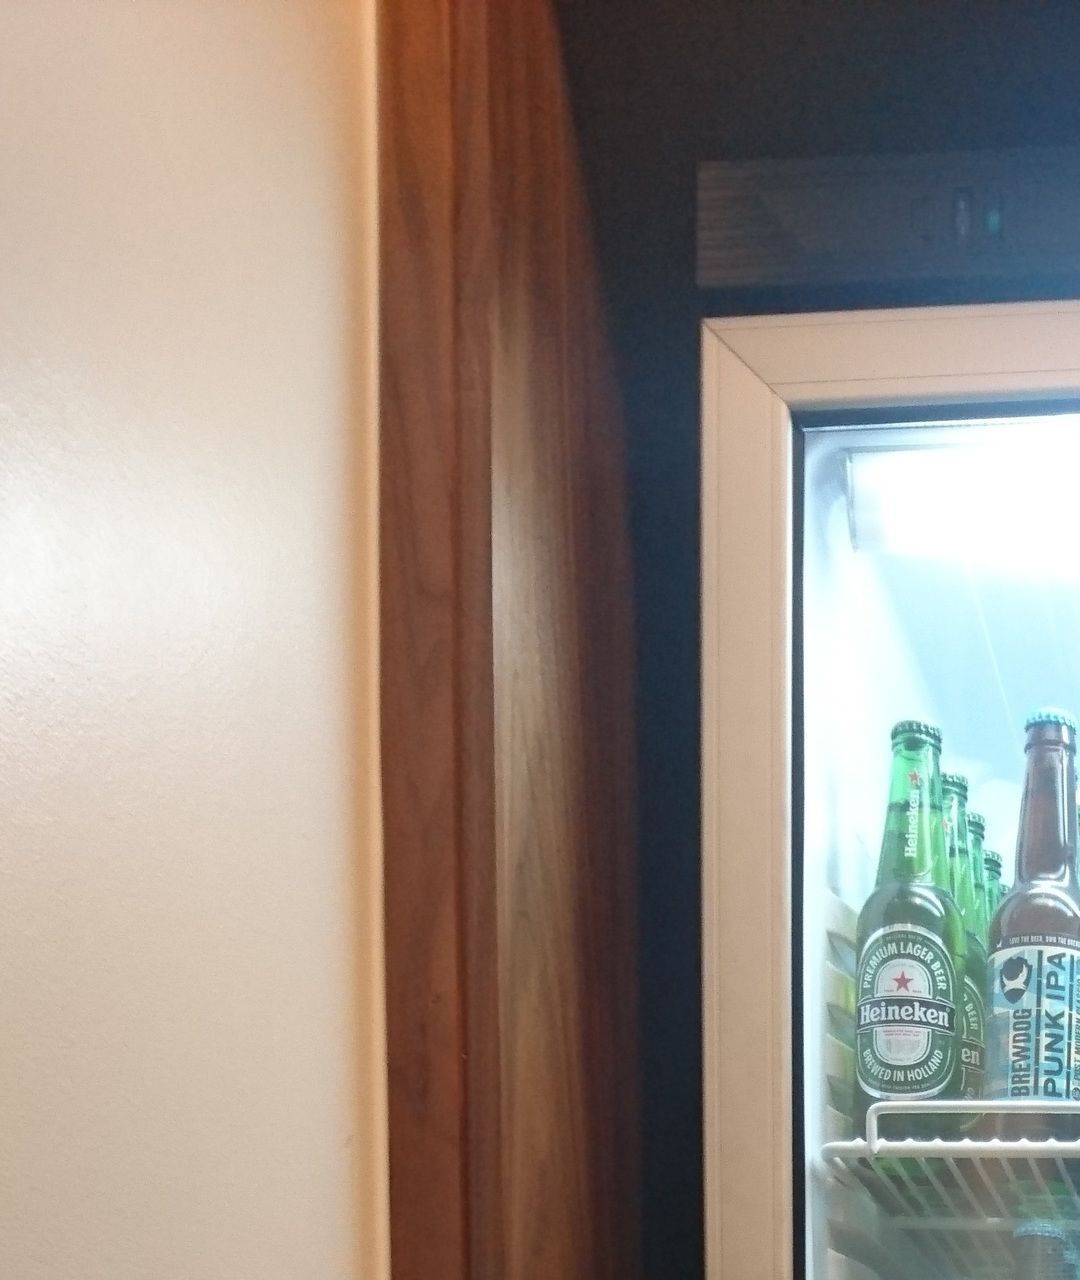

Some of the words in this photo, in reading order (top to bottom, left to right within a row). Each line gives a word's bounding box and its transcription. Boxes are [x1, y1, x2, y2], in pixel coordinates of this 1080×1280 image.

[863, 943, 898, 989] PREMIUM
[900, 941, 936, 964] LAGER
[930, 959, 947, 991] BEER
[1045, 952, 1066, 1002] IPA
[860, 1001, 949, 1027] Heineken
[863, 1049, 891, 1081] BREWED
[893, 1070, 905, 1082] IN
[906, 1049, 944, 1082] HOLLAND
[1010, 1008, 1032, 1098] BREWDOG
[1043, 1009, 1066, 1098] PUNK
